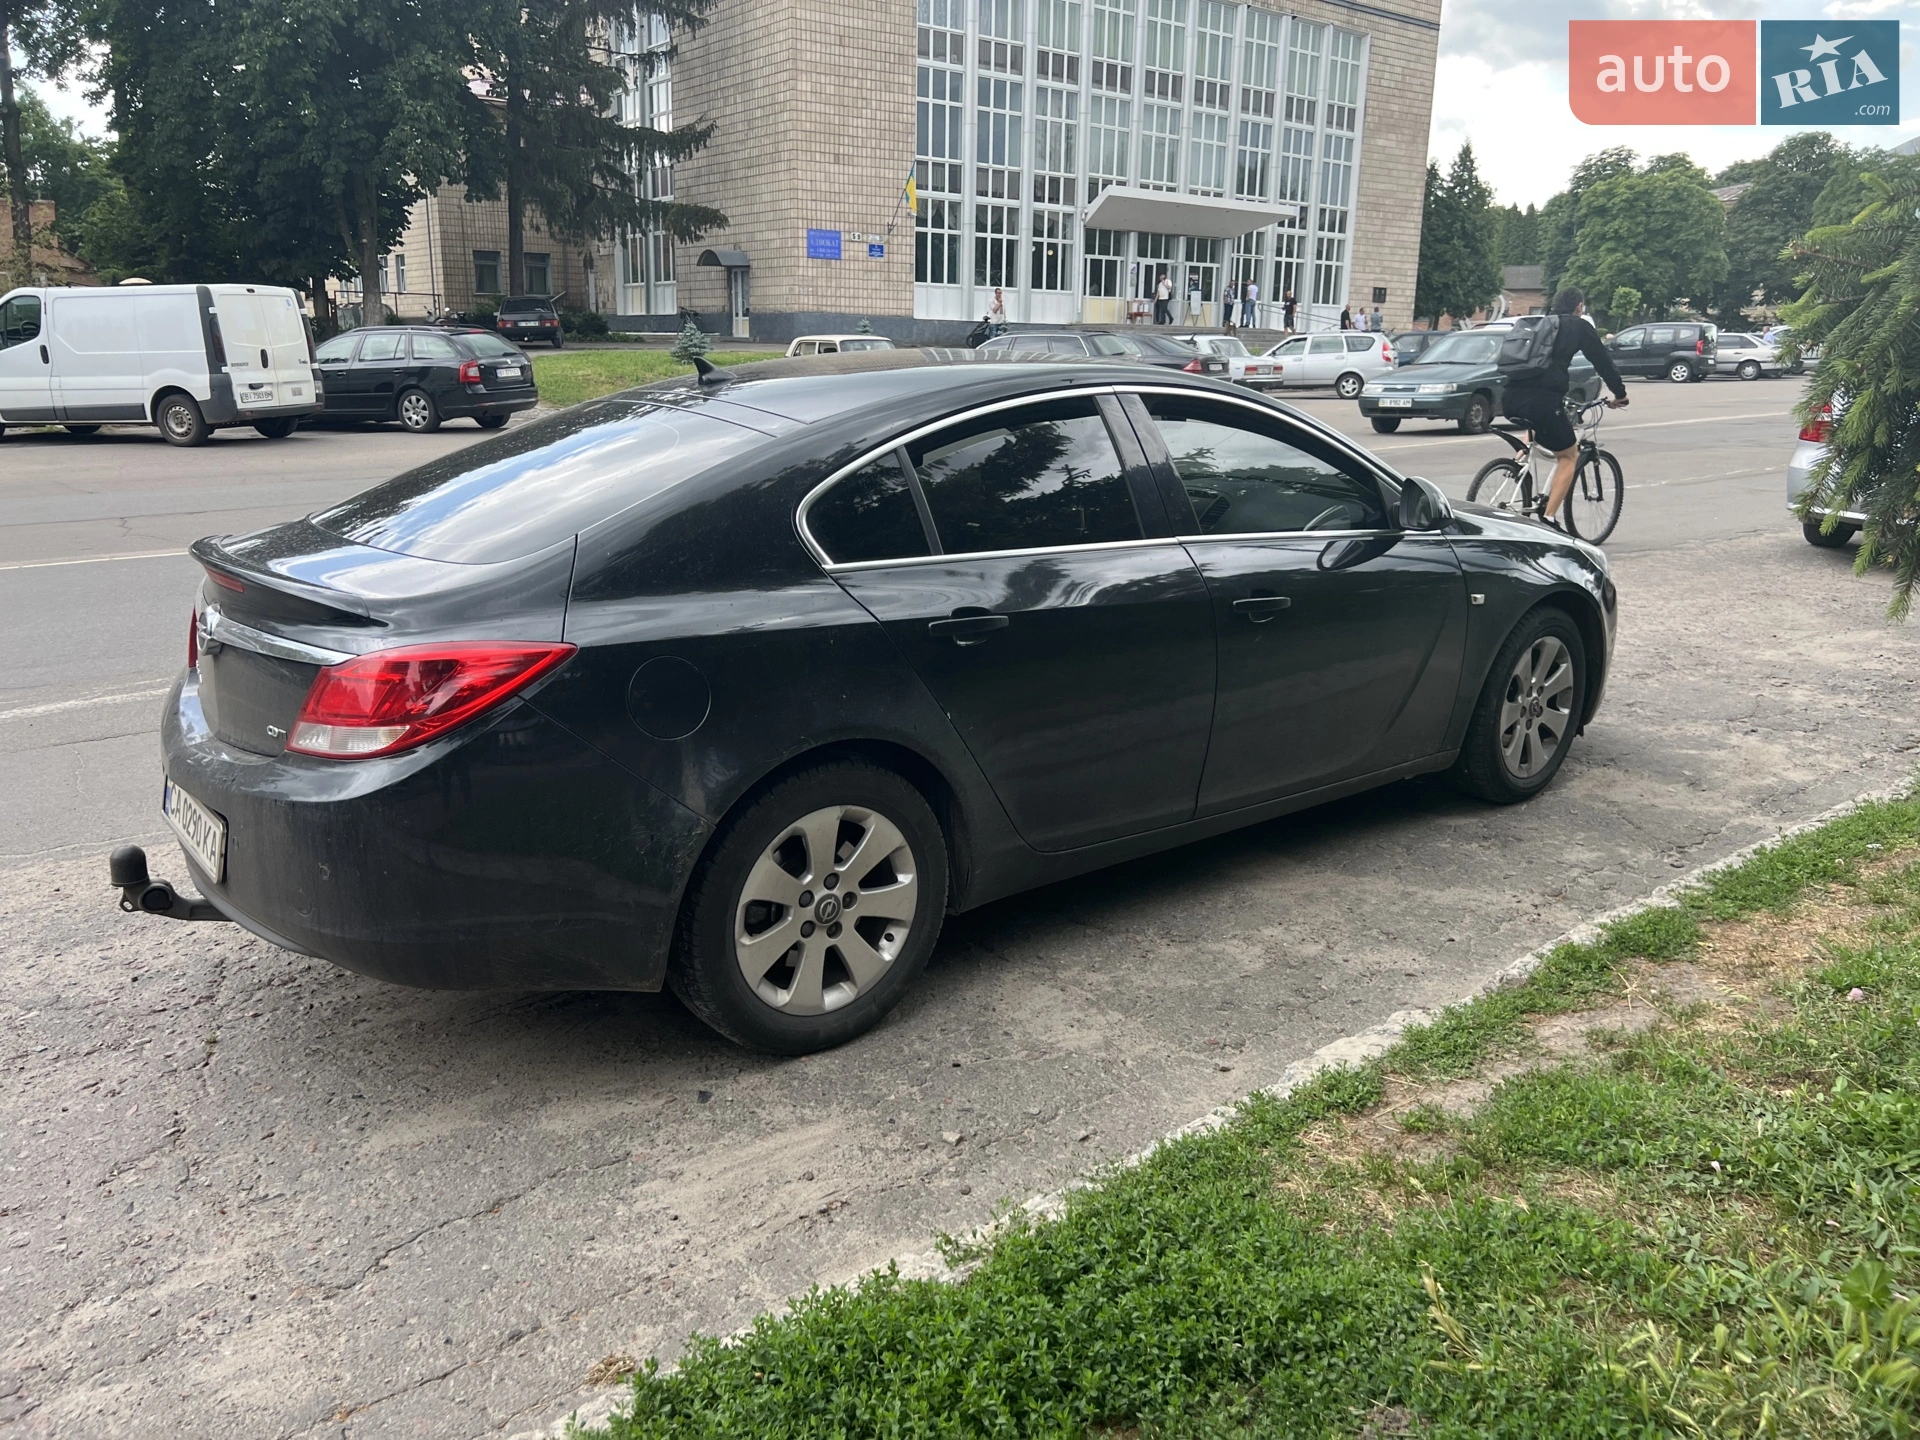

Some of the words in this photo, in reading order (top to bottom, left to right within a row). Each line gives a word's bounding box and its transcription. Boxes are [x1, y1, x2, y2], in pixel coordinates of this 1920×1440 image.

[170, 782, 181, 823] CA
[181, 796, 203, 848] 0290
[202, 819, 217, 868] KA
